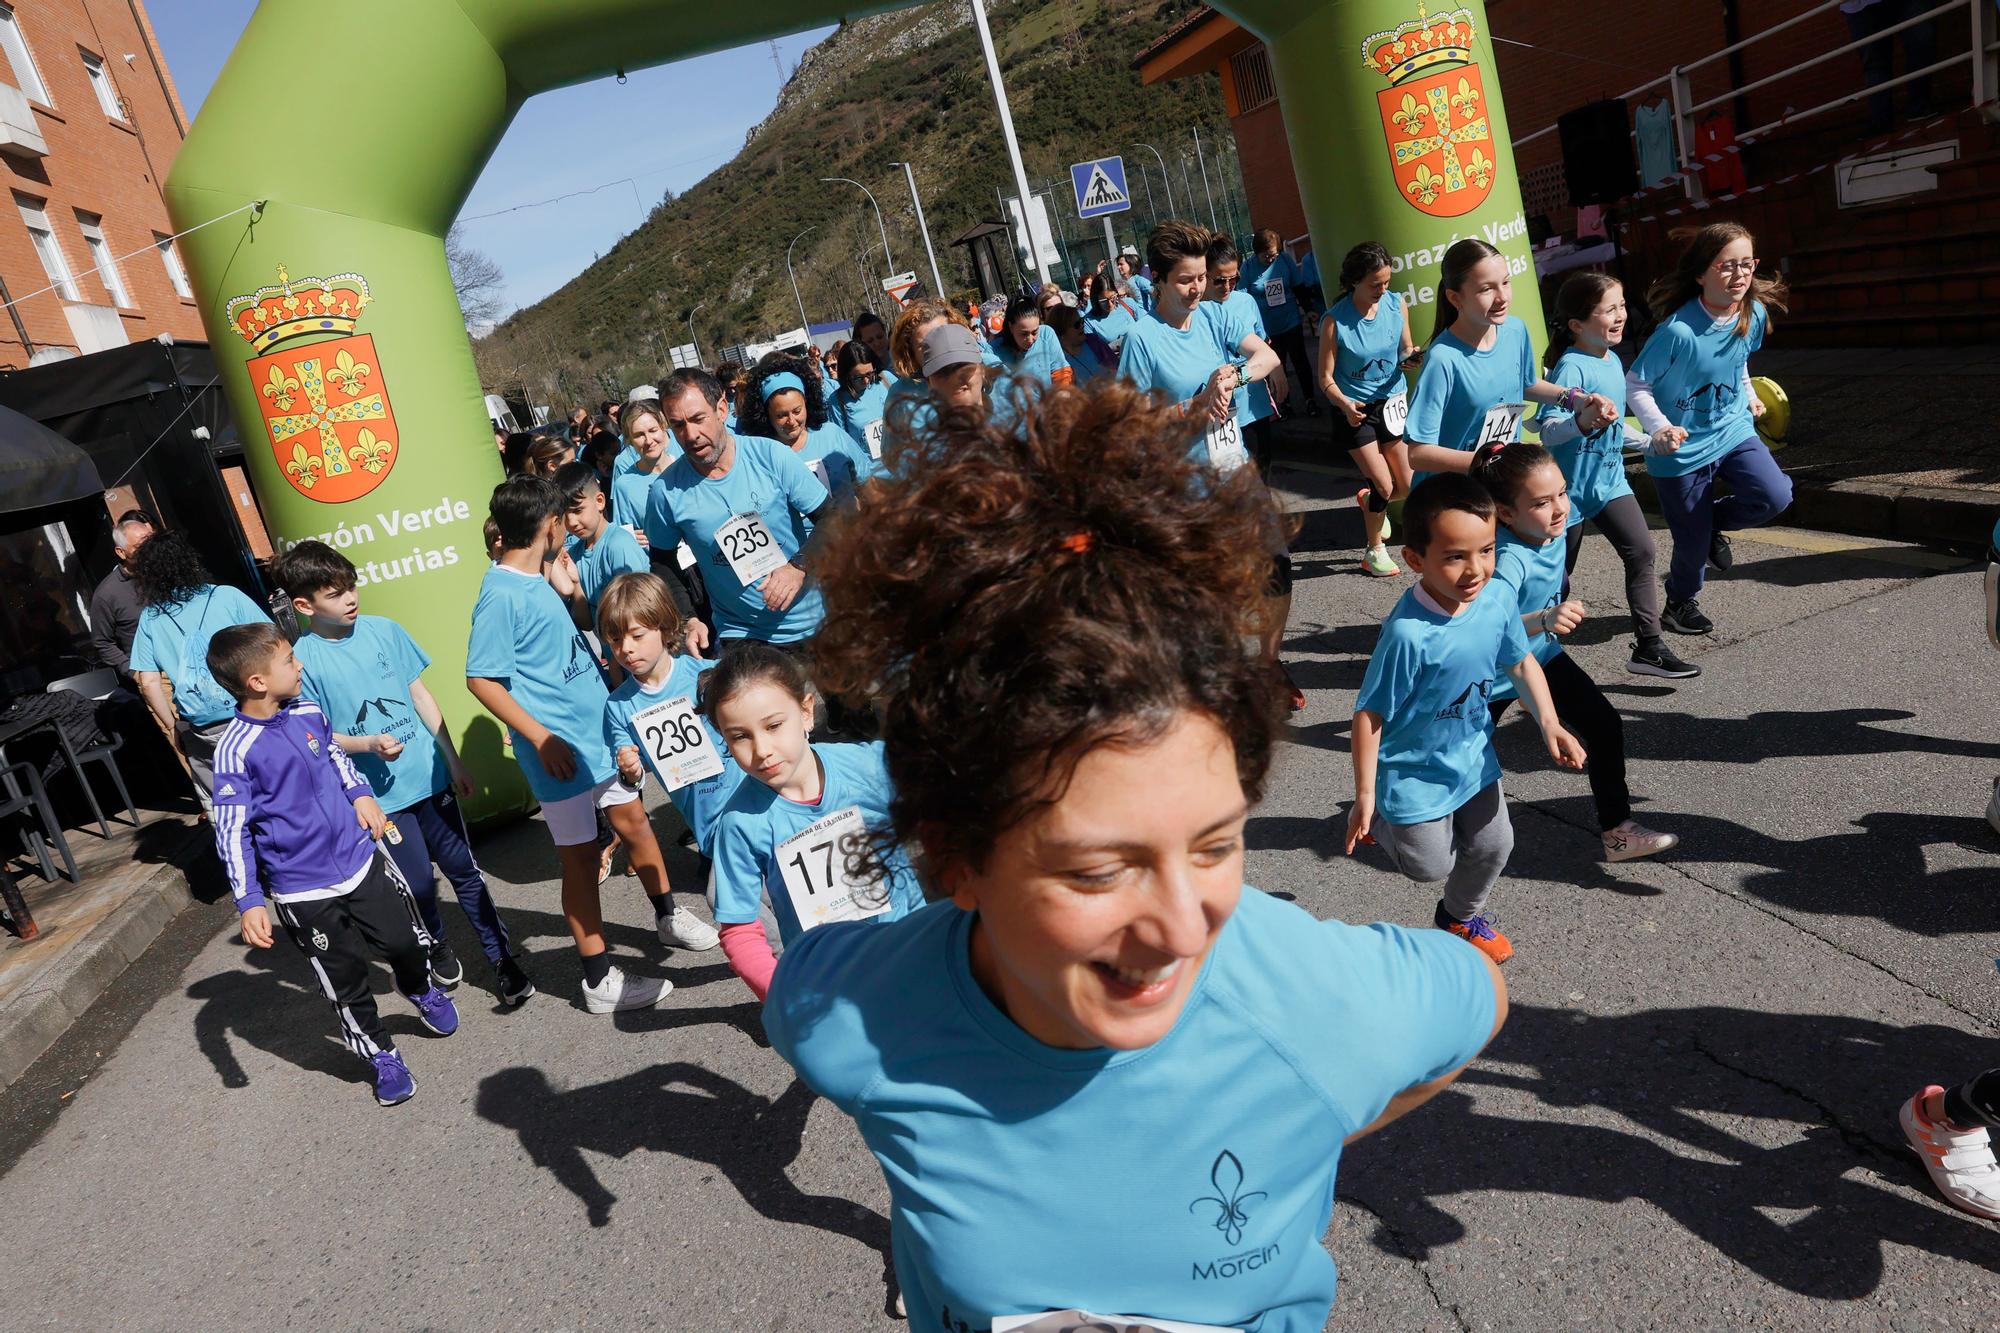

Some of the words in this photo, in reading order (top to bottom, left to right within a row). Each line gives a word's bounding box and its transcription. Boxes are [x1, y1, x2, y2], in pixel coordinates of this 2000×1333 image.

[1266, 283, 1283, 297] 229
[1401, 283, 1434, 307] de
[1386, 400, 1406, 422] 116
[1212, 418, 1237, 450] 143
[1487, 412, 1513, 442] 144
[376, 497, 471, 537] Verde
[723, 521, 769, 561] 235
[355, 545, 460, 587] sturias
[645, 713, 703, 760] 236
[814, 822, 822, 831] DE
